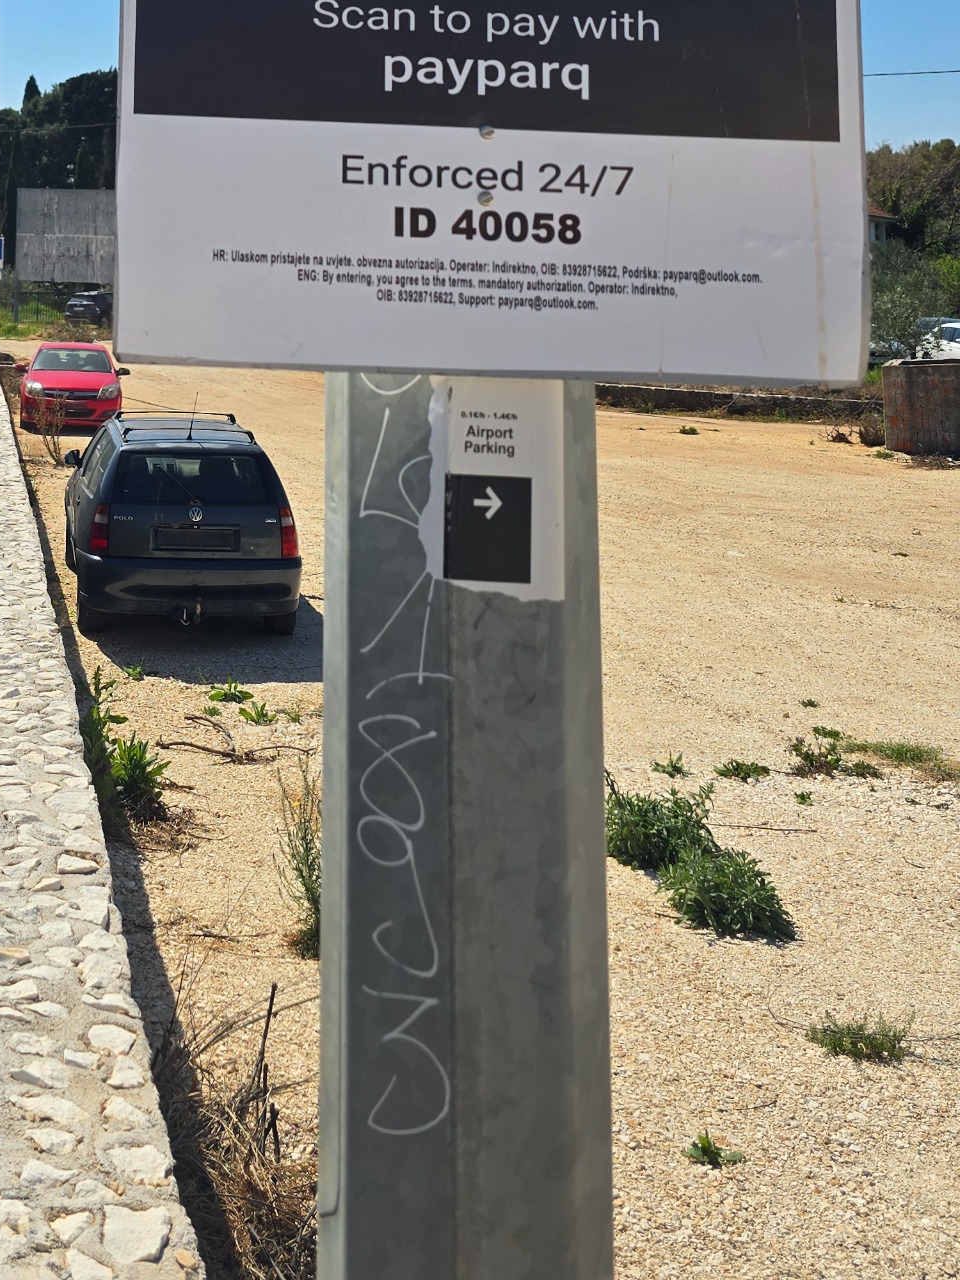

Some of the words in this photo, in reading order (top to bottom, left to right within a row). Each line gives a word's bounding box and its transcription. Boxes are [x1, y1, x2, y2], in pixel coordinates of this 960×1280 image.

[431, 4, 470, 34] to
[486, 10, 559, 45] pay
[573, 9, 660, 41] with
[384, 54, 590, 99] payparq
[341, 155, 524, 191] Enforced
[538, 164, 634, 197] 24/7
[394, 207, 436, 237] ID
[452, 211, 582, 244] 40058
[213, 249, 228, 261] HR:
[231, 251, 268, 264] Ulaskom
[271, 252, 310, 267] pristajete
[313, 257, 323, 266] na
[357, 255, 392, 268] obvezna
[449, 259, 489, 273] Operater:
[492, 261, 538, 275] Indirektno,
[541, 263, 559, 275] OIB:
[562, 264, 620, 280] 83928715622,
[622, 266, 660, 280] Podrška:
[663, 269, 762, 285] payparq@outlook.com.
[297, 269, 320, 282] ENG:
[323, 270, 334, 285] By
[376, 275, 393, 287] you
[395, 276, 419, 288] agree
[421, 276, 431, 286] to
[433, 275, 446, 287] the
[478, 278, 524, 293] mandatory
[588, 282, 629, 296] Operator:
[631, 283, 678, 298] Indirektno,
[376, 289, 396, 301] OIB:
[458, 292, 496, 308] Support:
[498, 295, 599, 312] payparq@outlook.com.
[464, 440, 515, 458] Parking
[466, 425, 513, 440] Airport
